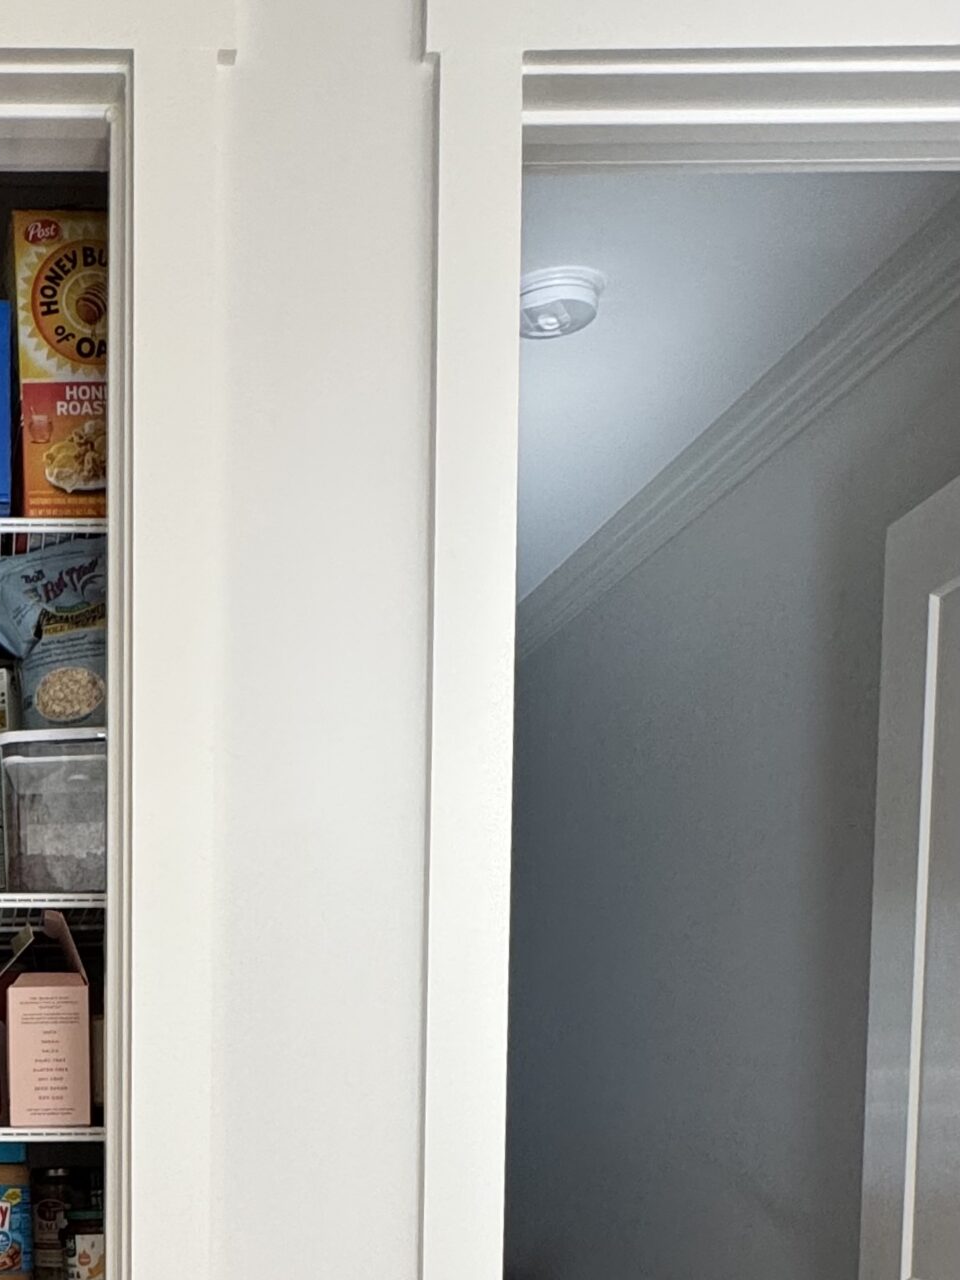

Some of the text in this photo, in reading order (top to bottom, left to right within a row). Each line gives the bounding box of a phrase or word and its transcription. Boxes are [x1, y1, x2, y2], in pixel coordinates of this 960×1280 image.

[28, 222, 57, 241] Post
[39, 249, 78, 316] HONEY
[54, 325, 75, 344] of
[65, 385, 107, 400] HON
[56, 401, 107, 416] ROAS
